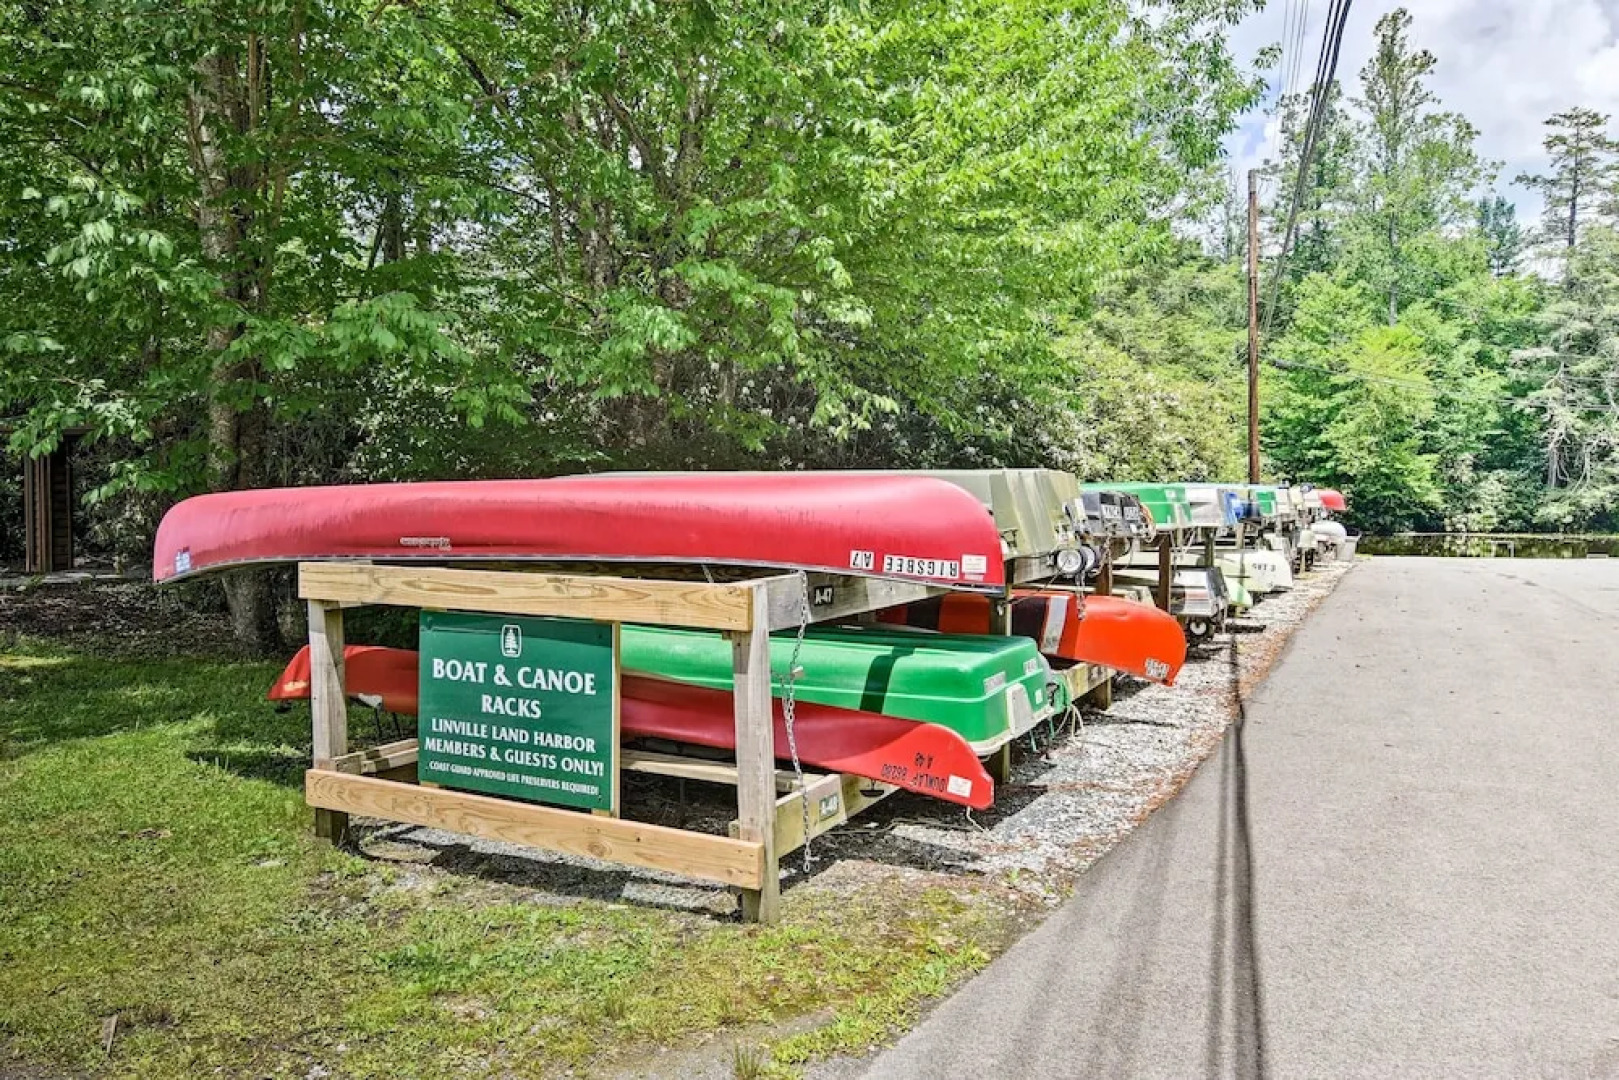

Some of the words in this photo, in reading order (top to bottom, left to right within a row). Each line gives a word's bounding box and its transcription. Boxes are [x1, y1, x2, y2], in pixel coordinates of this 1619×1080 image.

[886, 556, 958, 577] RIGSBEE
[432, 658, 487, 683] BOAT
[493, 664, 513, 687] &
[517, 666, 596, 695] CANOE
[481, 694, 542, 719] RACKS
[431, 718, 488, 738] LINVILLE
[491, 725, 529, 744] LAND
[533, 731, 596, 753] HARBOR
[424, 737, 487, 759] MEMBERS
[489, 747, 502, 762] &
[504, 749, 557, 770] GUESTS
[561, 758, 605, 777] ONLY!
[428, 760, 450, 772] COAST
[449, 764, 472, 776] GUARD
[472, 767, 506, 781] APPROVED
[506, 773, 520, 783] LIFE
[521, 775, 561, 790] PRESERVERS
